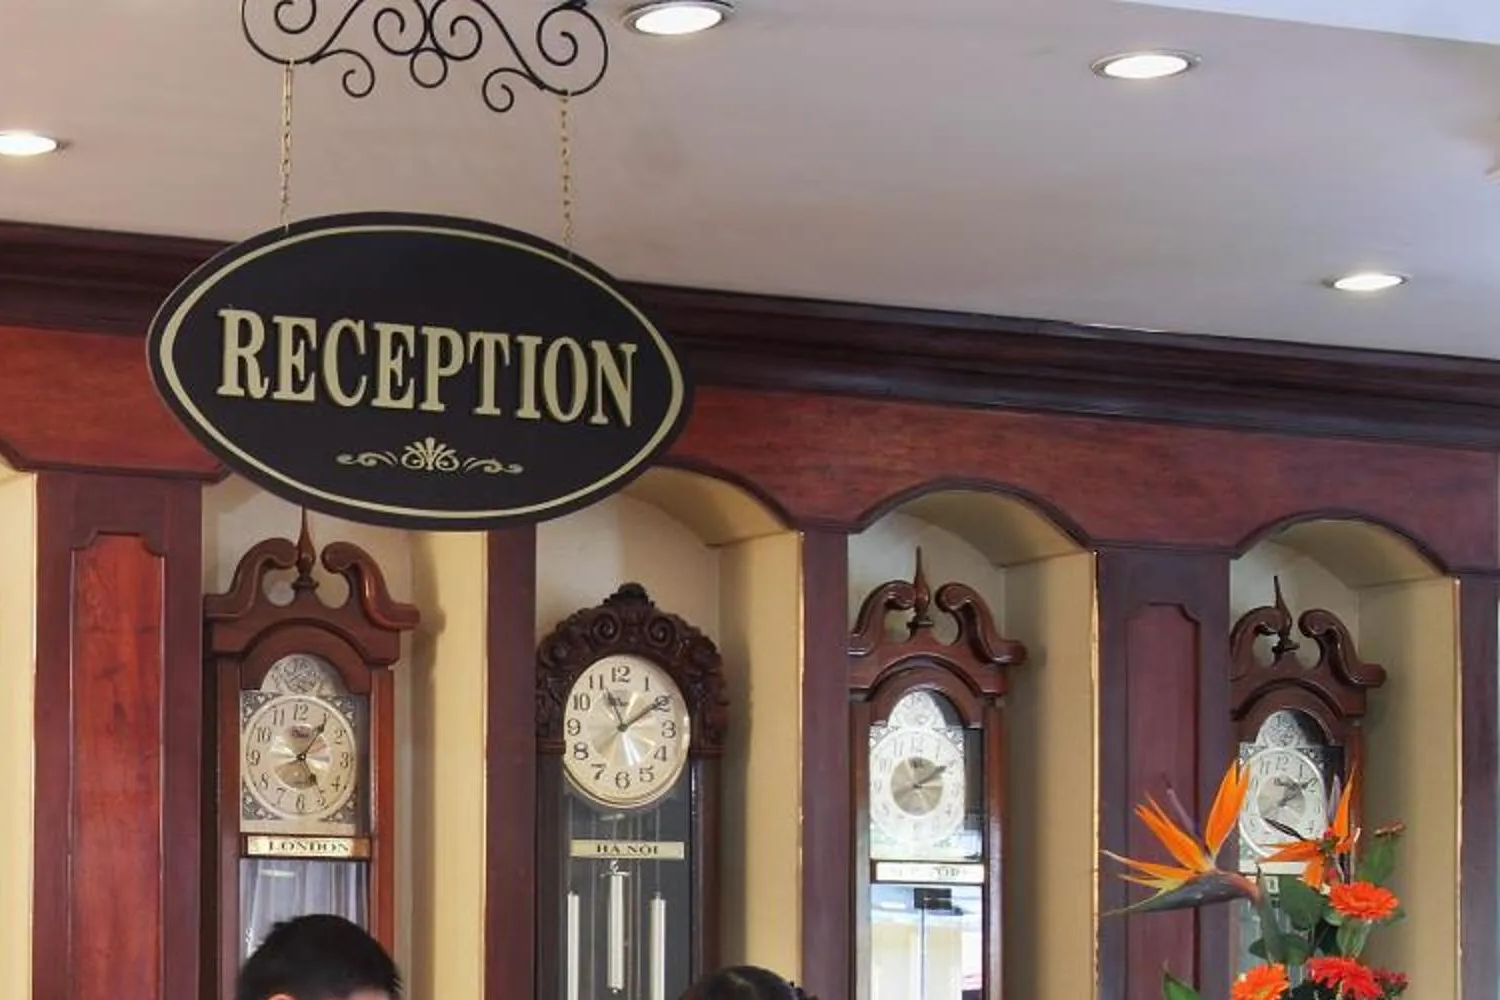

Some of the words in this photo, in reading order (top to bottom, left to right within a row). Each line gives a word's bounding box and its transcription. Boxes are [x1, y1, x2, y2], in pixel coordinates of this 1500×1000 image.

[216, 308, 637, 427] RECEPTION
[589, 674, 605, 691] 11
[611, 665, 631, 683] 12
[644, 676, 650, 692] 1
[573, 693, 591, 711] 10
[272, 708, 285, 725] 11
[293, 703, 309, 720] 12
[255, 727, 271, 743] 10
[567, 718, 581, 736] 9
[661, 720, 677, 738] 3
[573, 742, 589, 761] 8
[654, 746, 667, 762] 4
[340, 753, 349, 769] 3
[591, 763, 607, 780] 7
[639, 766, 655, 783] 5
[260, 772, 270, 789] 8
[331, 776, 341, 792] 4
[615, 771, 631, 790] 6
[276, 787, 285, 807] 7
[296, 794, 305, 811] 6
[269, 840, 350, 852] LONDON
